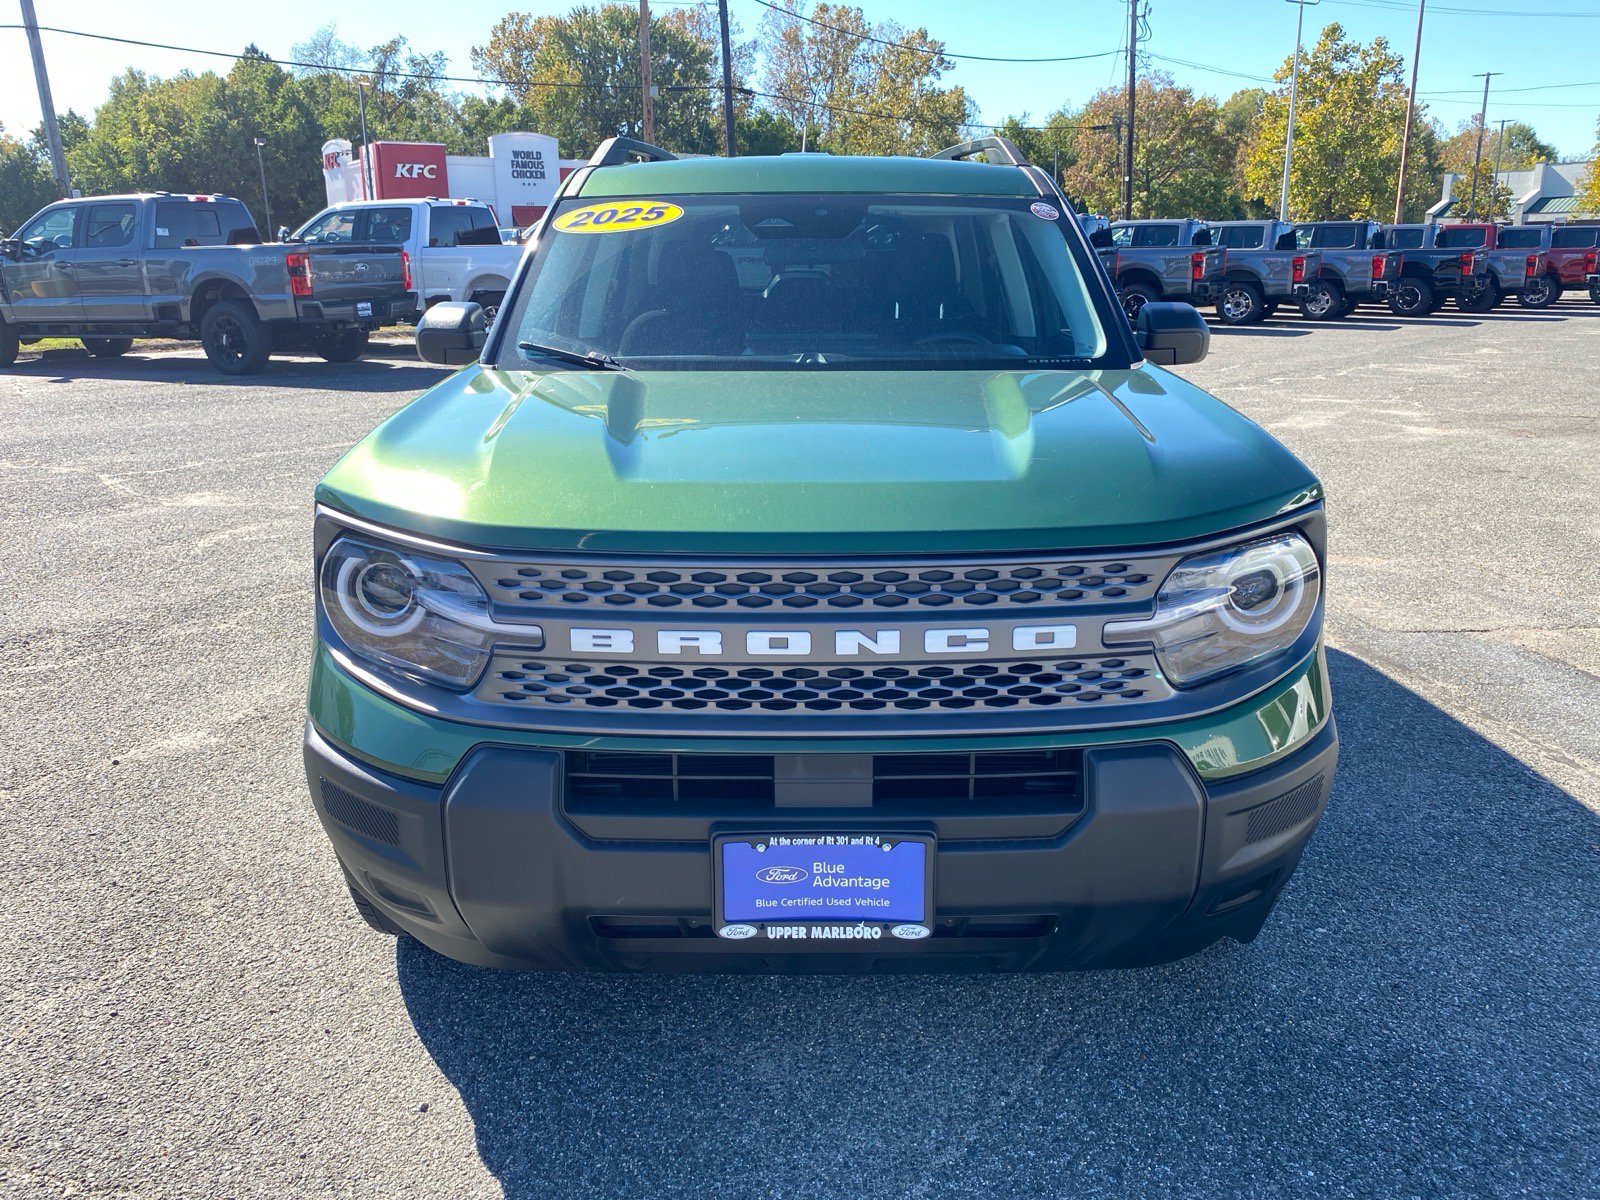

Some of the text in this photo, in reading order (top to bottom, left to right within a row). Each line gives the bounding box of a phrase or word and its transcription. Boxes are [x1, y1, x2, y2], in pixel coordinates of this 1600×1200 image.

[512, 150, 542, 160] WORLD
[395, 163, 437, 179] KFC
[511, 160, 545, 170] FAMOUS
[511, 169, 546, 179] CHICKEN
[565, 206, 670, 228] 2025
[570, 625, 1077, 655] BRONCO
[769, 836, 880, 846] At the corner of Rt 301 and Rt 4
[813, 862, 845, 874] Blue
[765, 868, 798, 881] Ford
[812, 876, 891, 890] Advantage
[755, 897, 890, 907] Blue Certified Used Vehicle
[767, 925, 882, 939] UPPER MARLBORO
